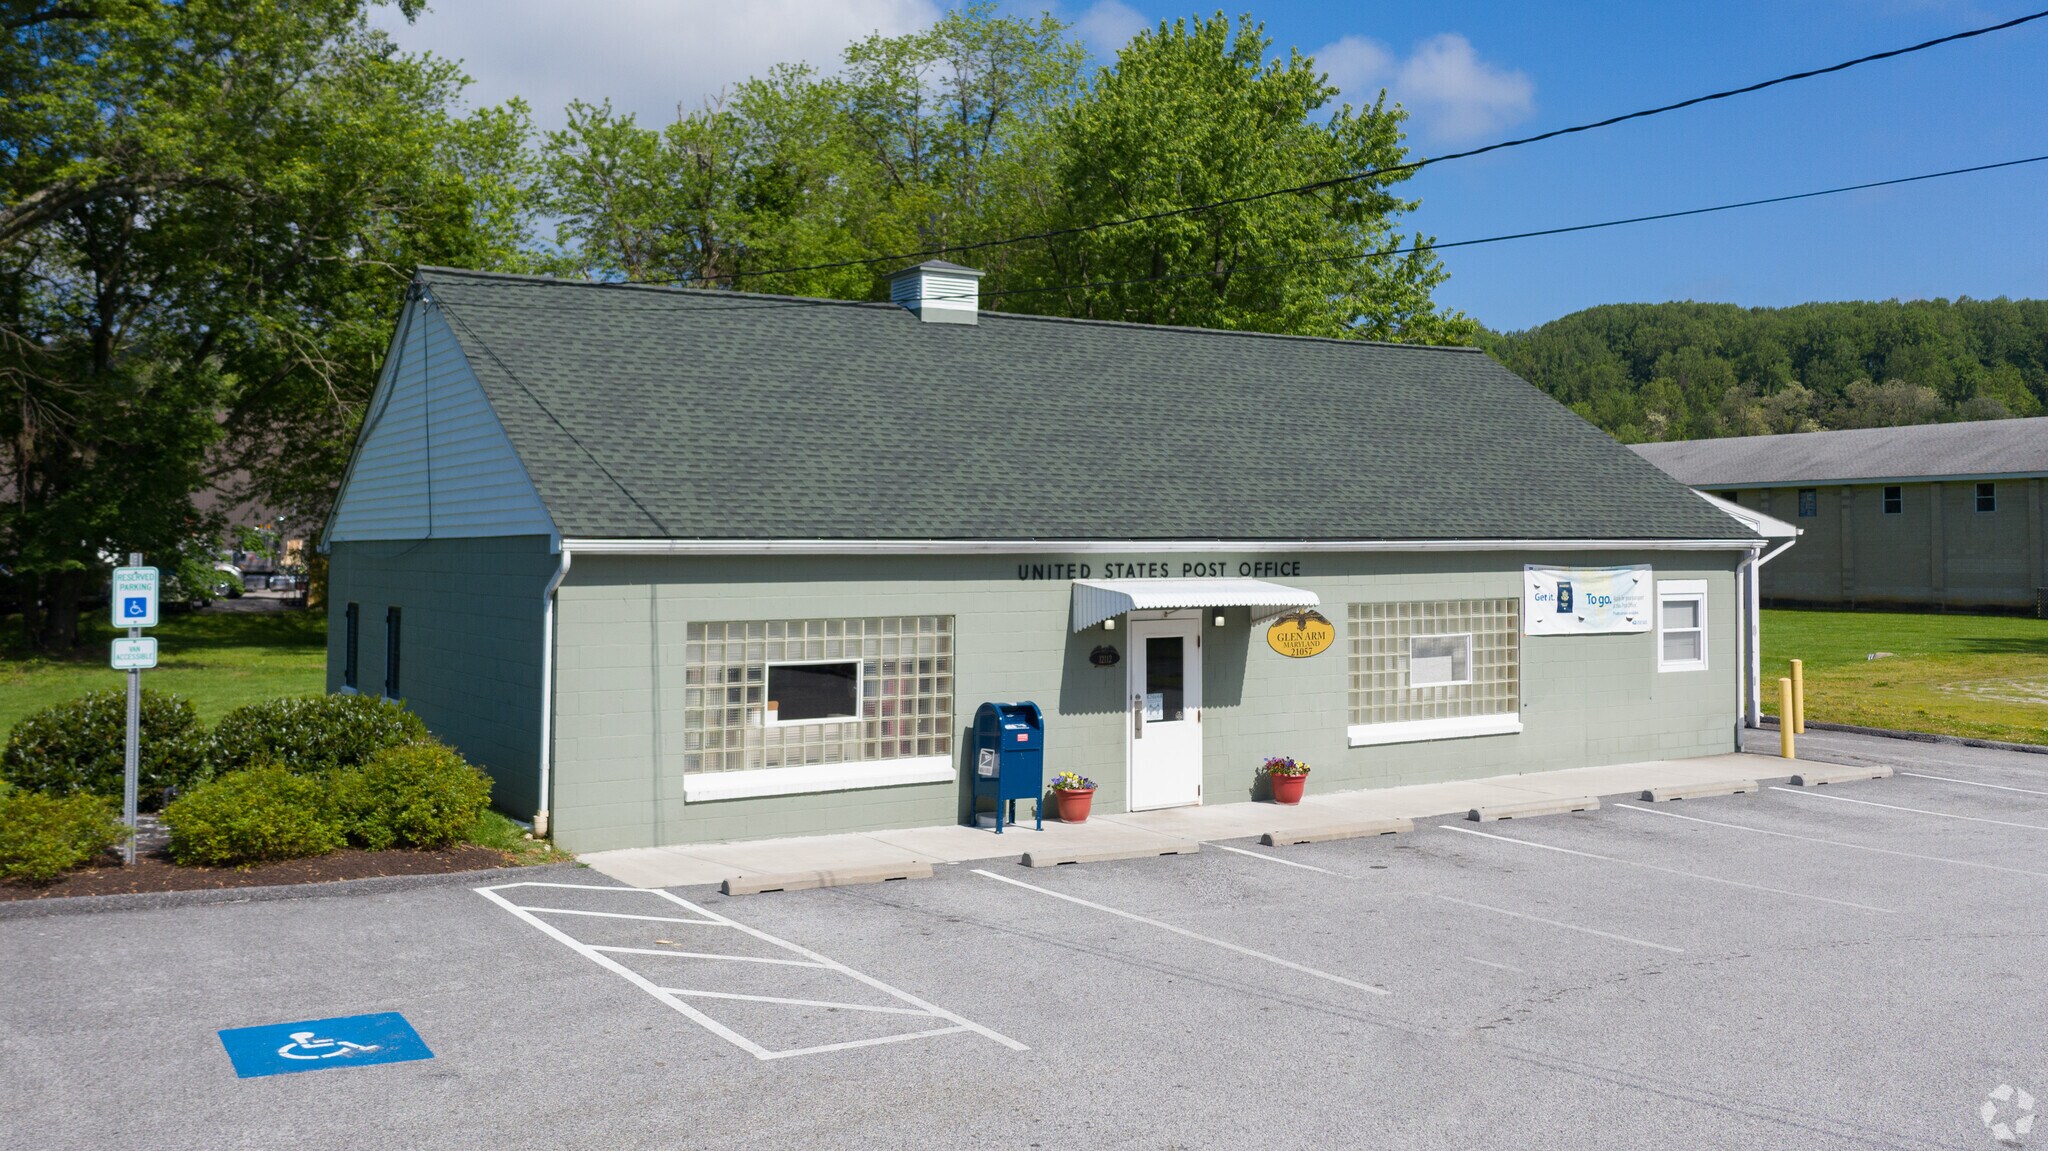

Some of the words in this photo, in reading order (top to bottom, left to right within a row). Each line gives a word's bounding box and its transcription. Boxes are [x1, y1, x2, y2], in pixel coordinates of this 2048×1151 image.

[1018, 564, 1091, 580] UNITED
[1105, 562, 1169, 578] STATES
[1183, 562, 1226, 577] POST
[1239, 561, 1301, 577] OFFICE
[117, 573, 155, 582] RESERVED
[120, 583, 152, 591] PARKING
[1535, 593, 1548, 601] Get
[1586, 593, 1597, 604] To
[1598, 595, 1612, 607] go.
[1277, 632, 1303, 642] GLEN
[1305, 631, 1326, 640] ARM
[1283, 640, 1320, 648] MARYLAND
[1291, 647, 1313, 656] 21057
